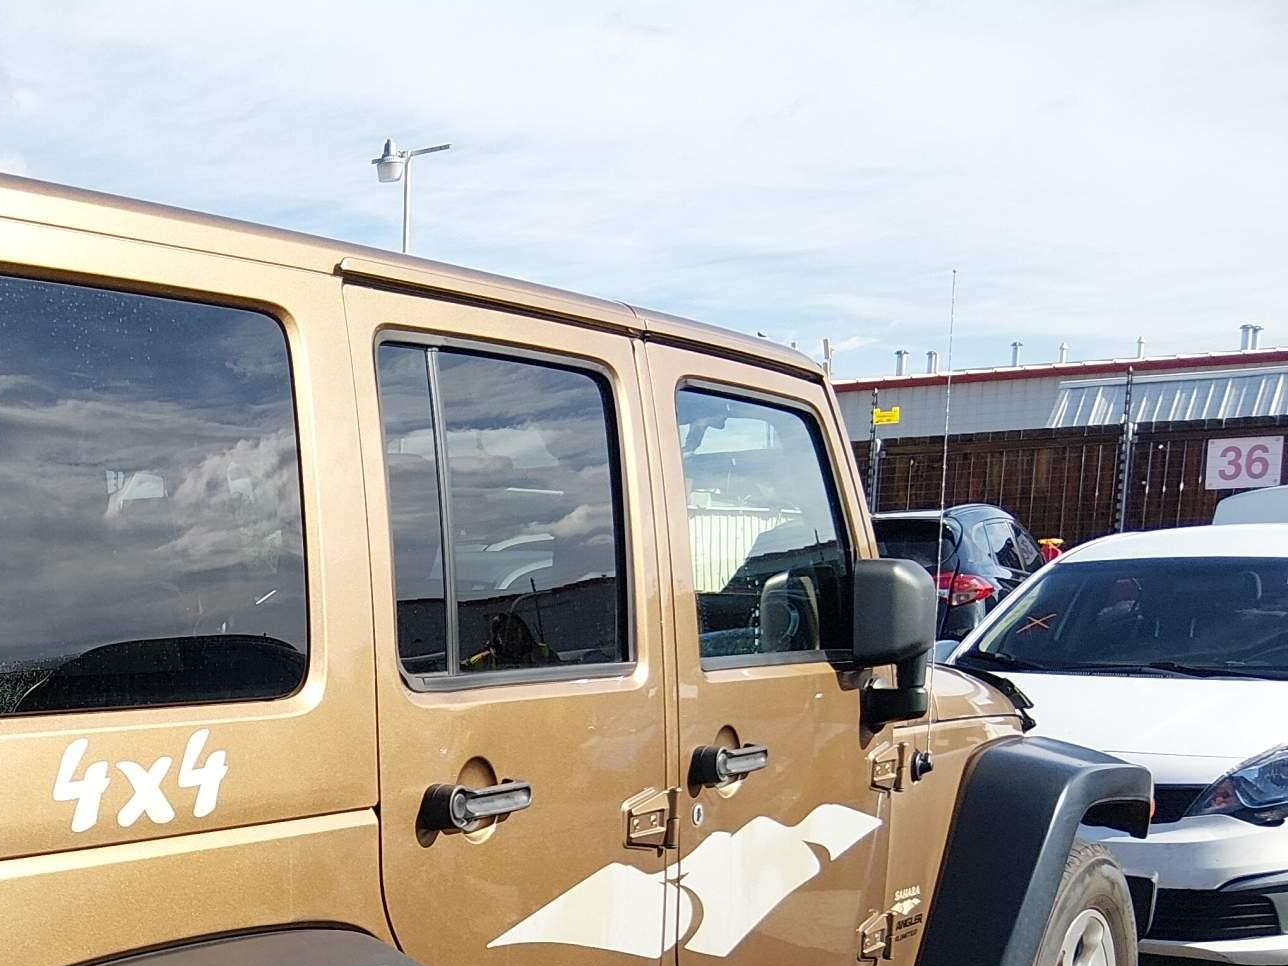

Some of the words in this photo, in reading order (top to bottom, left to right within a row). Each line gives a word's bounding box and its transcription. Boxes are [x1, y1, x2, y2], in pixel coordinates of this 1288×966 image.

[1217, 444, 1270, 481] 36
[53, 728, 230, 834] 4x4
[894, 885, 921, 901] SAHARA
